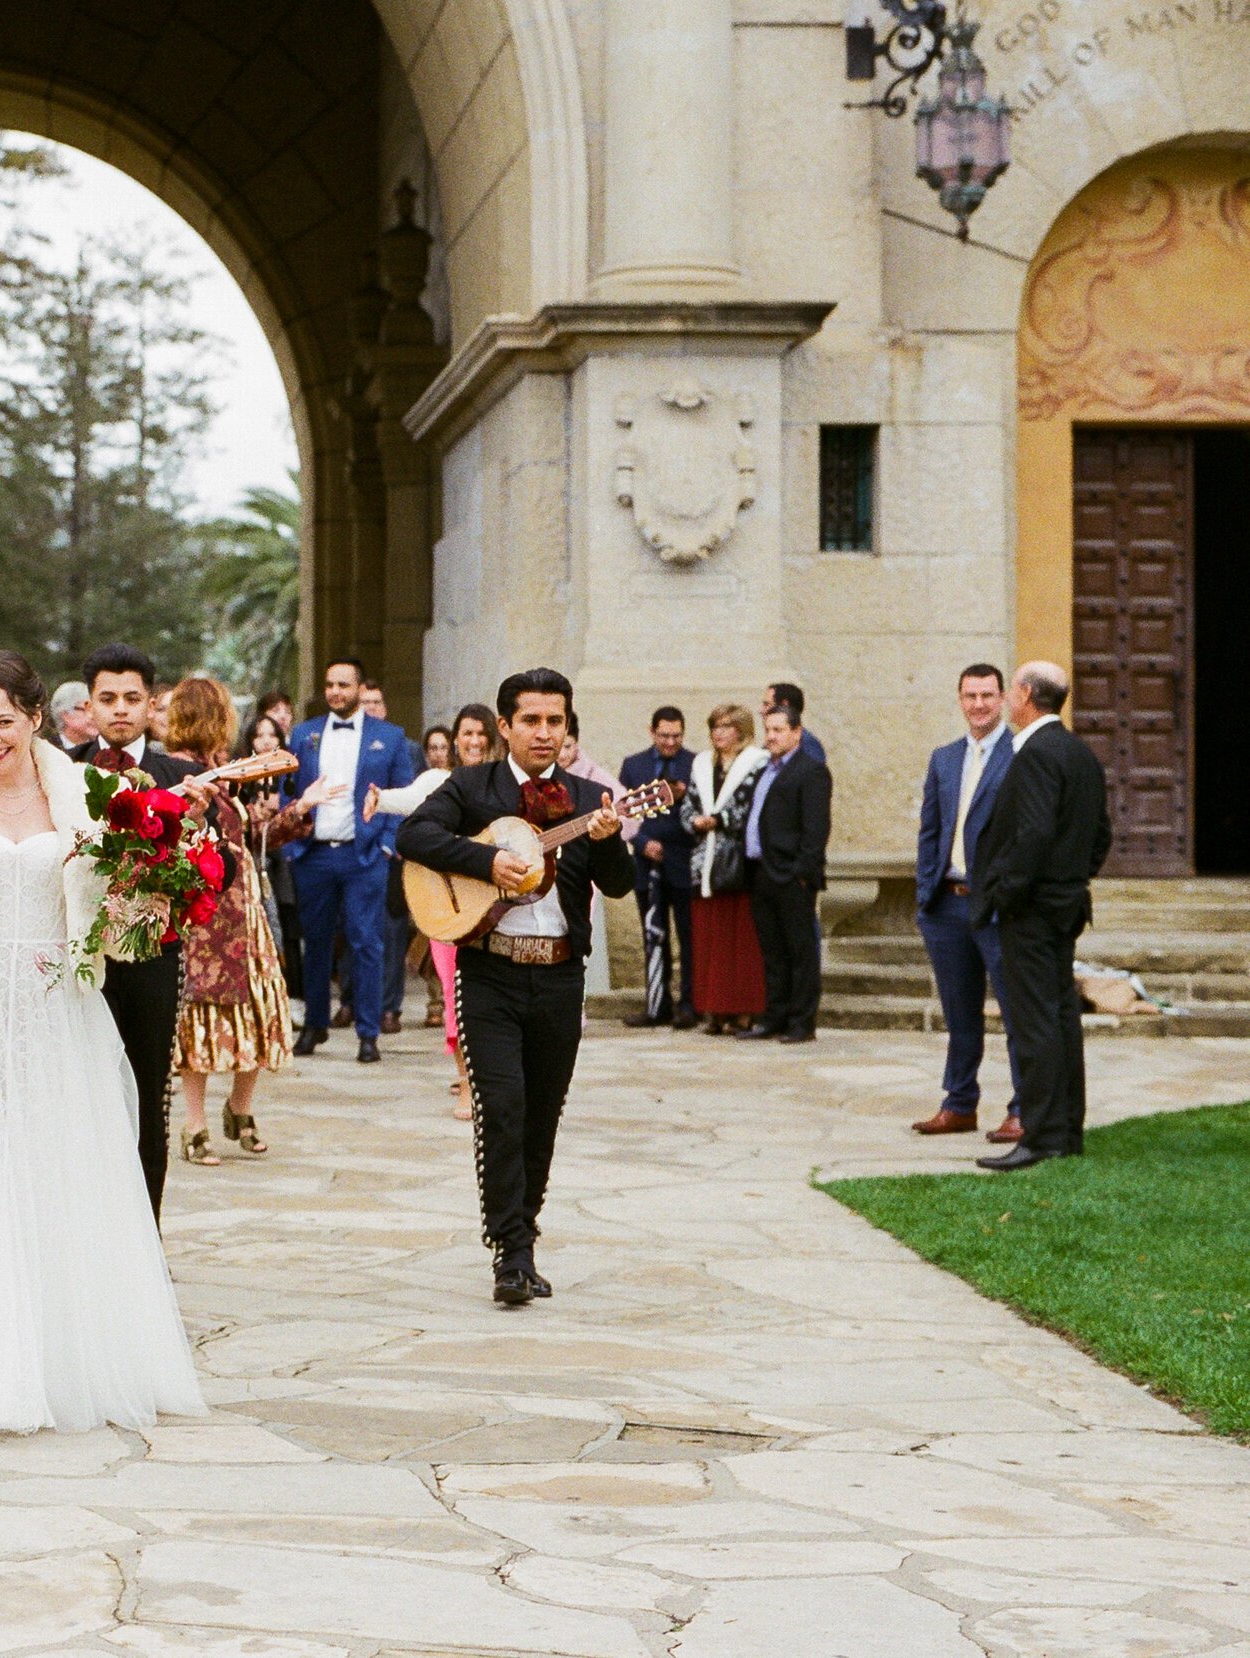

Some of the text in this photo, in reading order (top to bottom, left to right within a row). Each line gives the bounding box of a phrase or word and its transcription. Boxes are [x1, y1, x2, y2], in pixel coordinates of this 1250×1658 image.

[994, 0, 1061, 53] GOD
[1073, 28, 1111, 66] OF
[1125, 3, 1198, 38] MAN
